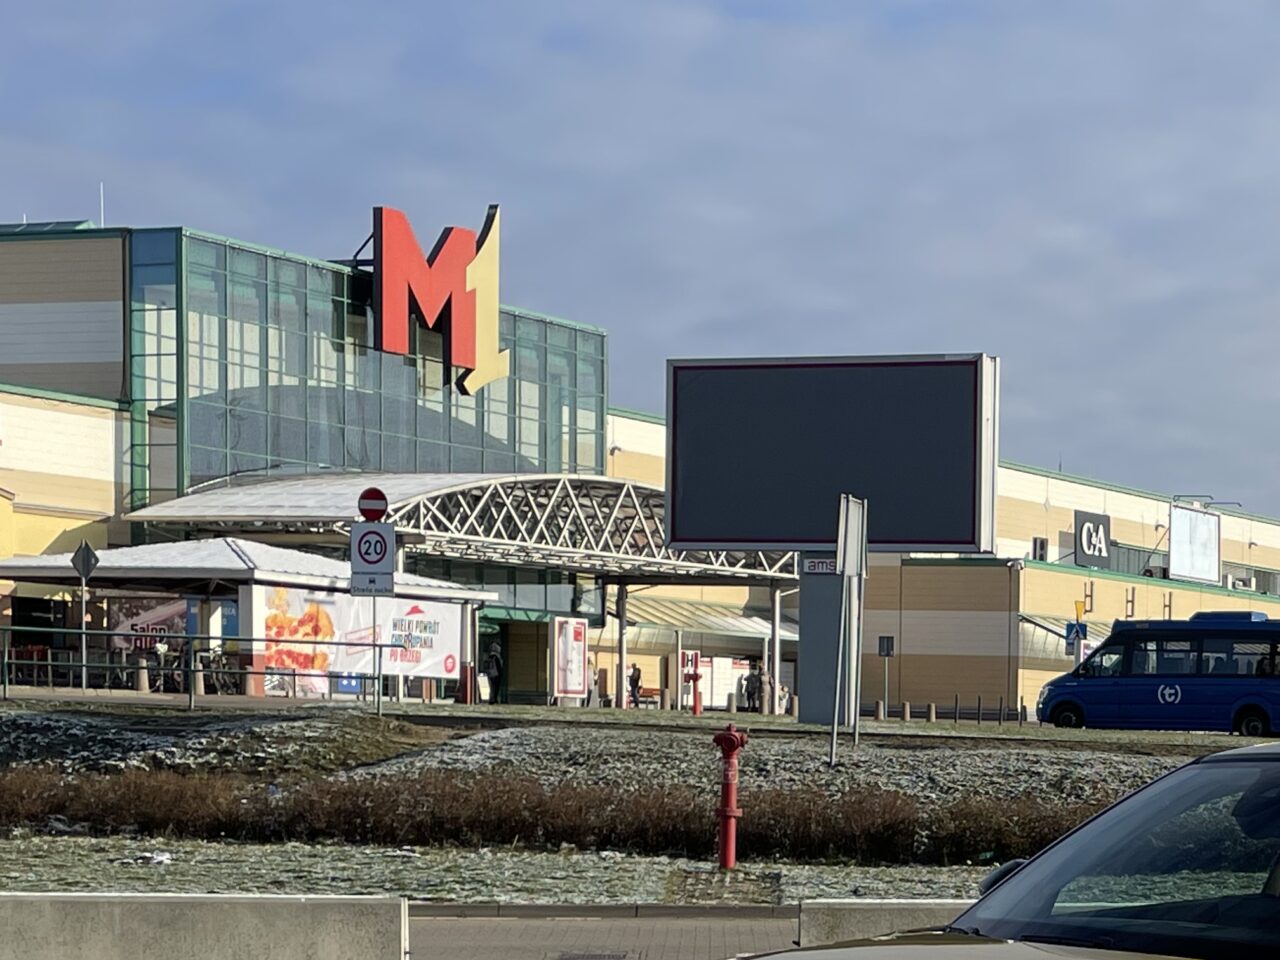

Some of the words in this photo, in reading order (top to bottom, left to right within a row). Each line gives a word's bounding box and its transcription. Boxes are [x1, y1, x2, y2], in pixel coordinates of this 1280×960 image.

[374, 204, 509, 396] M1
[363, 540, 383, 556] 20
[1082, 522, 1108, 557] C&A
[808, 560, 836, 571] ams
